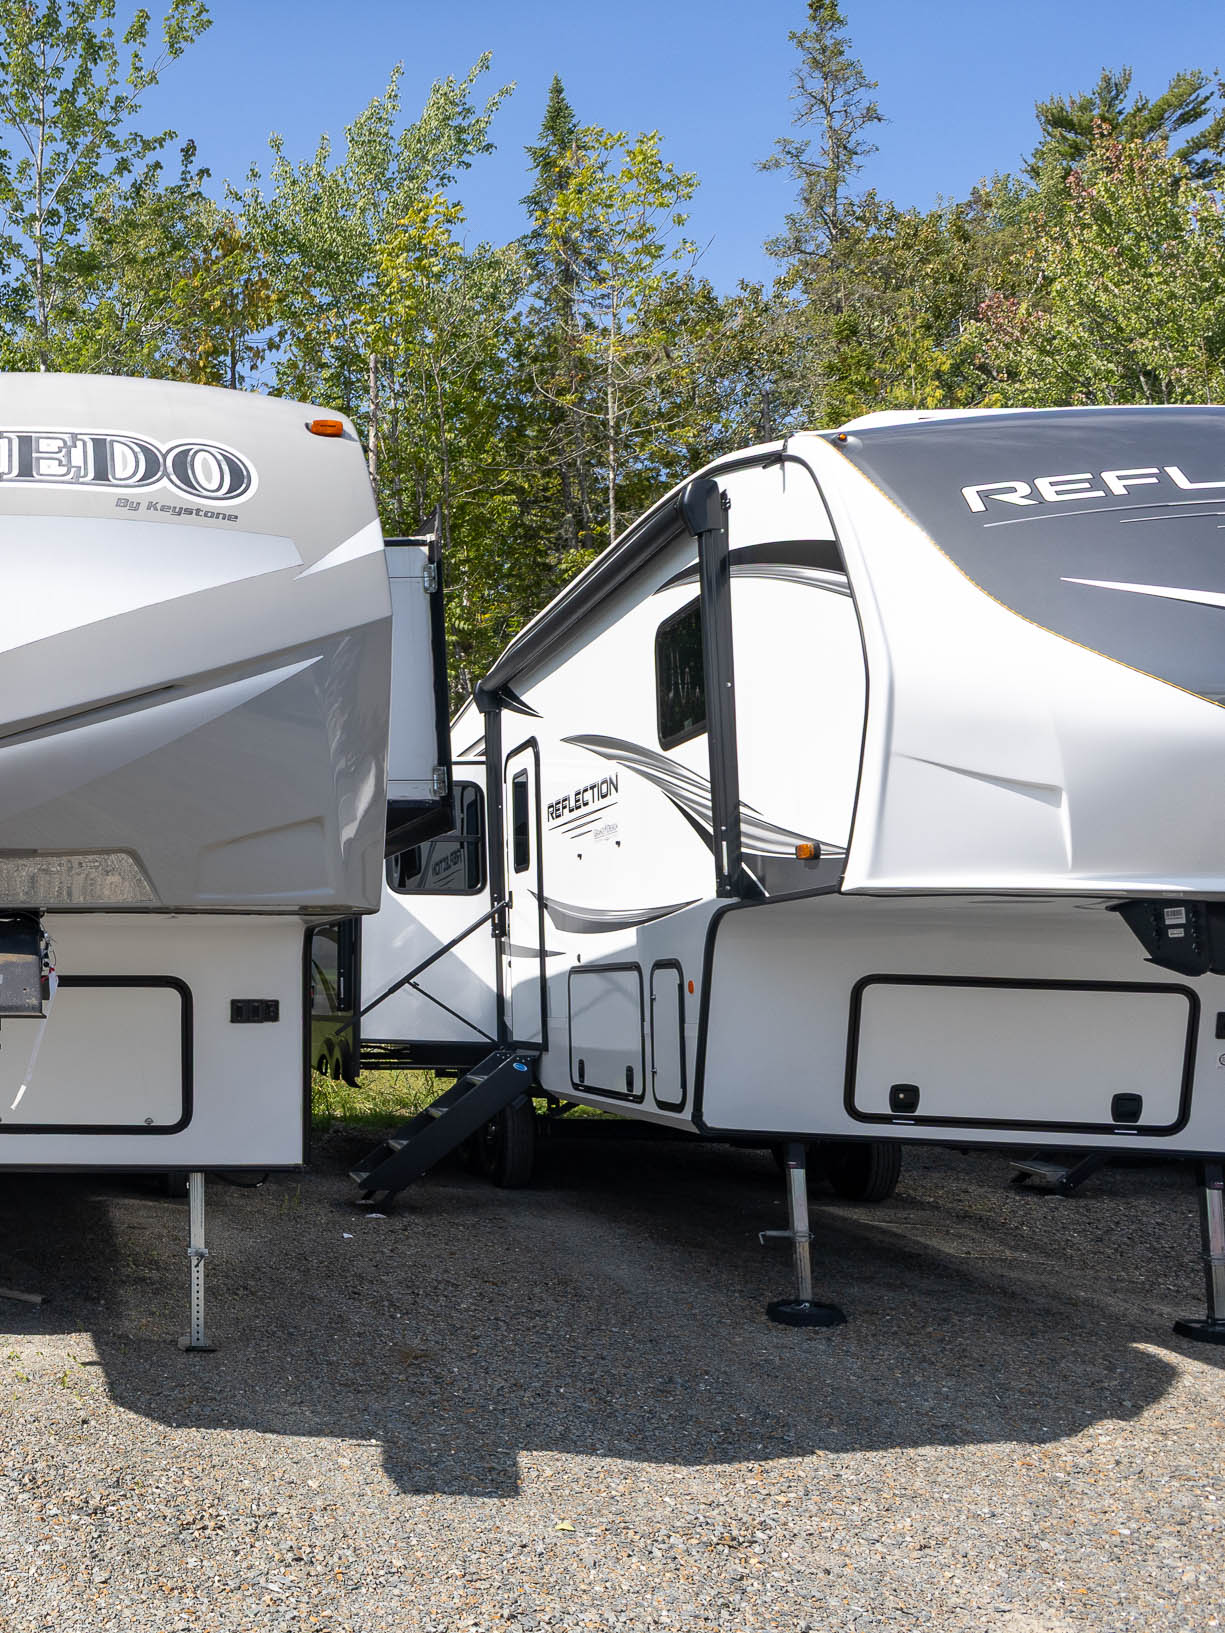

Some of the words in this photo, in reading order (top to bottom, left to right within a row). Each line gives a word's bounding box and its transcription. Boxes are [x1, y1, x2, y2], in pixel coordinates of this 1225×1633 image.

[115, 497, 141, 511] By
[146, 501, 239, 522] Keystone
[960, 465, 1225, 514] REFL
[547, 772, 619, 823] REFLECTION
